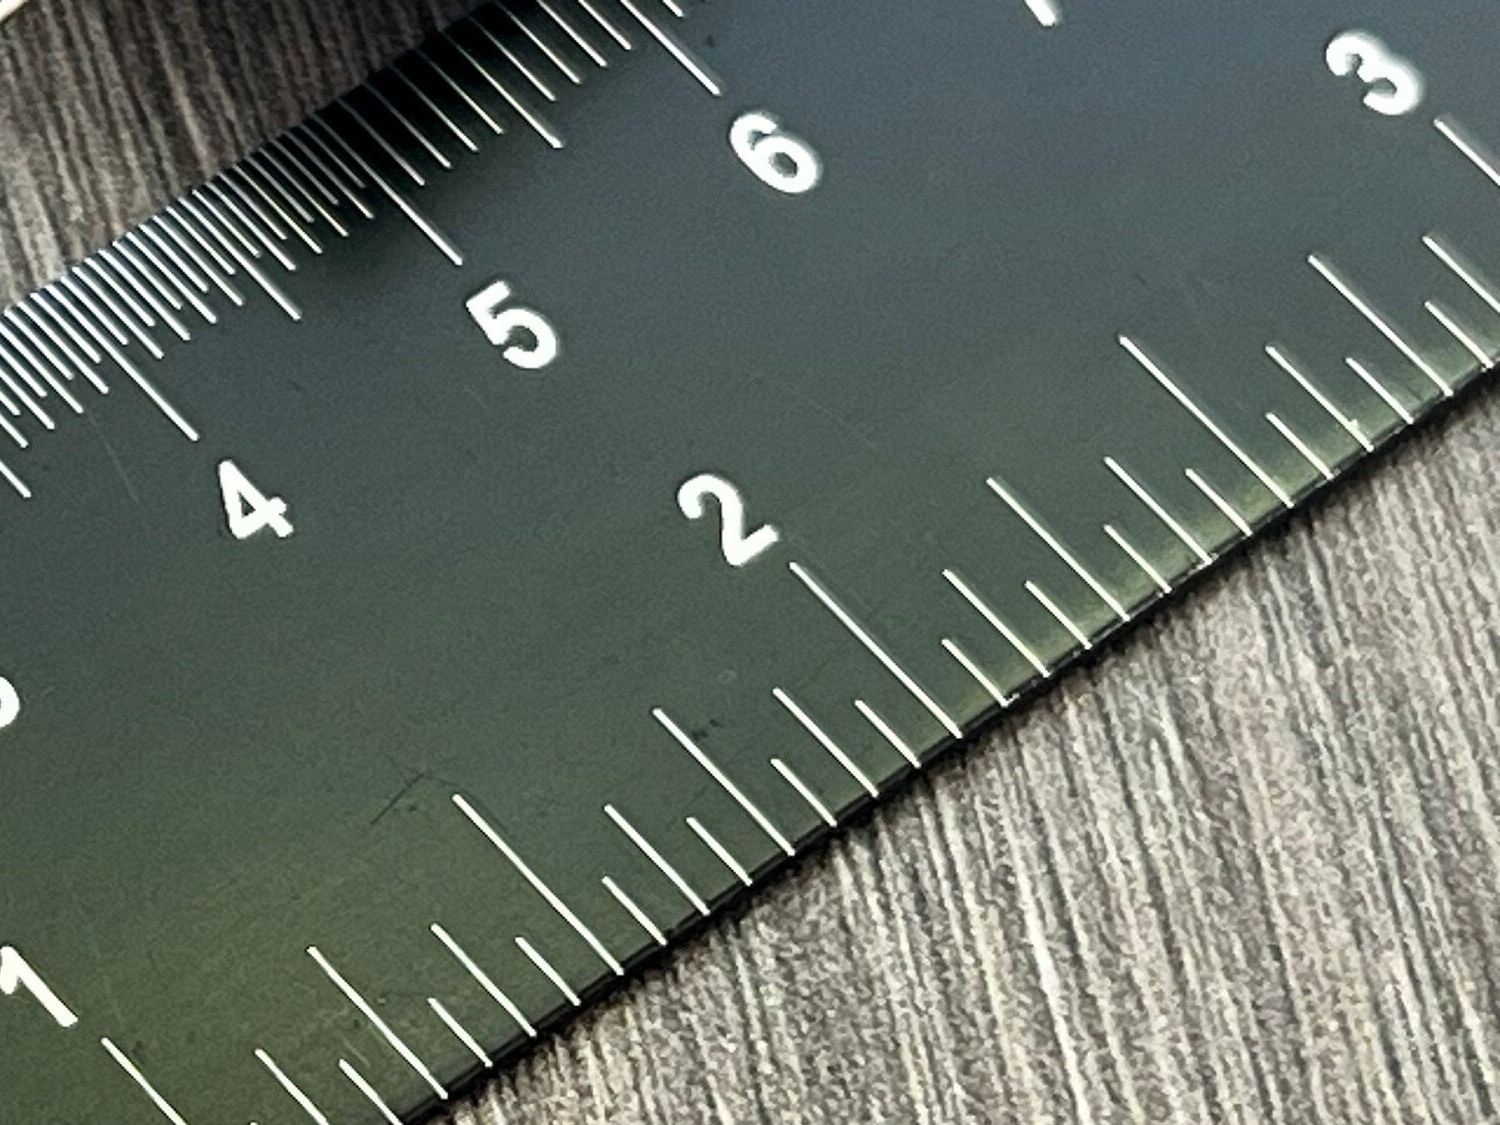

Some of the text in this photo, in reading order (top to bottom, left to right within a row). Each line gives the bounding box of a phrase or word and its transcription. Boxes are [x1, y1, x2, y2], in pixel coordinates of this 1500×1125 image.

[1324, 30, 1425, 117] 3
[728, 110, 822, 195] 6
[464, 279, 559, 370] 5
[217, 459, 295, 541] 4
[676, 472, 780, 569] 2
